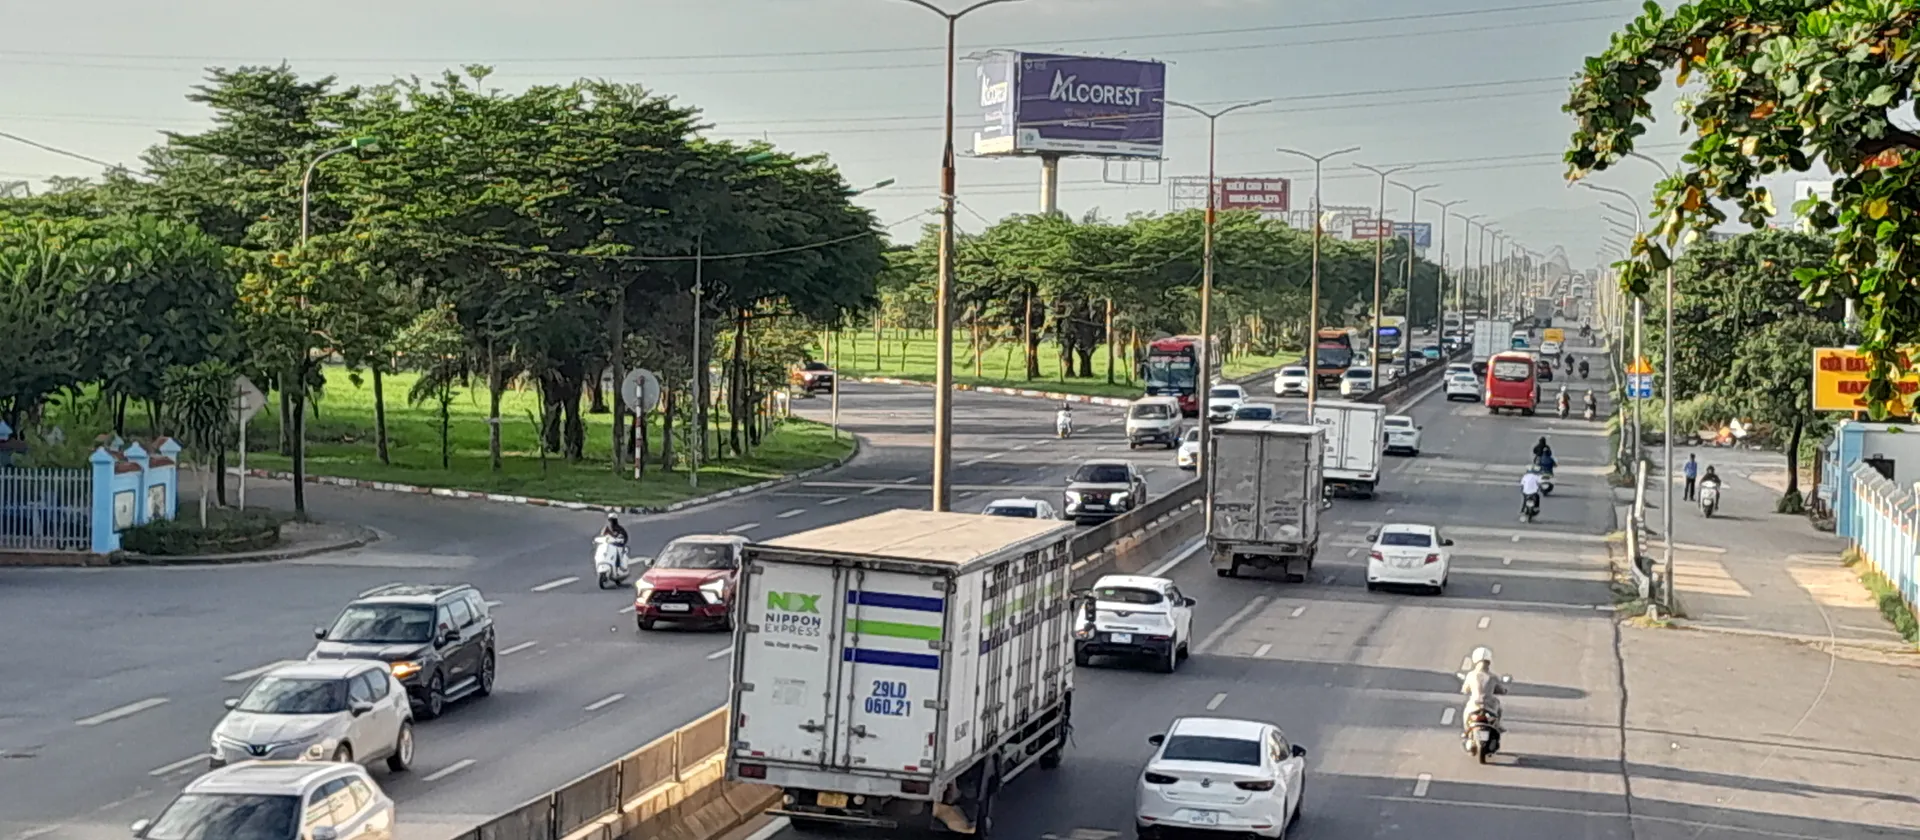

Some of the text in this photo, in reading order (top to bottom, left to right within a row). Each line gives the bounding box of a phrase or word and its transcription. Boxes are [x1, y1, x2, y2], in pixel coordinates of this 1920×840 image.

[1050, 69, 1142, 106] ALCOREST
[765, 612, 821, 626] NIPPON
[764, 622, 820, 637] EXPRESS
[872, 680, 907, 699] 29LD
[864, 697, 912, 717] 060.21
